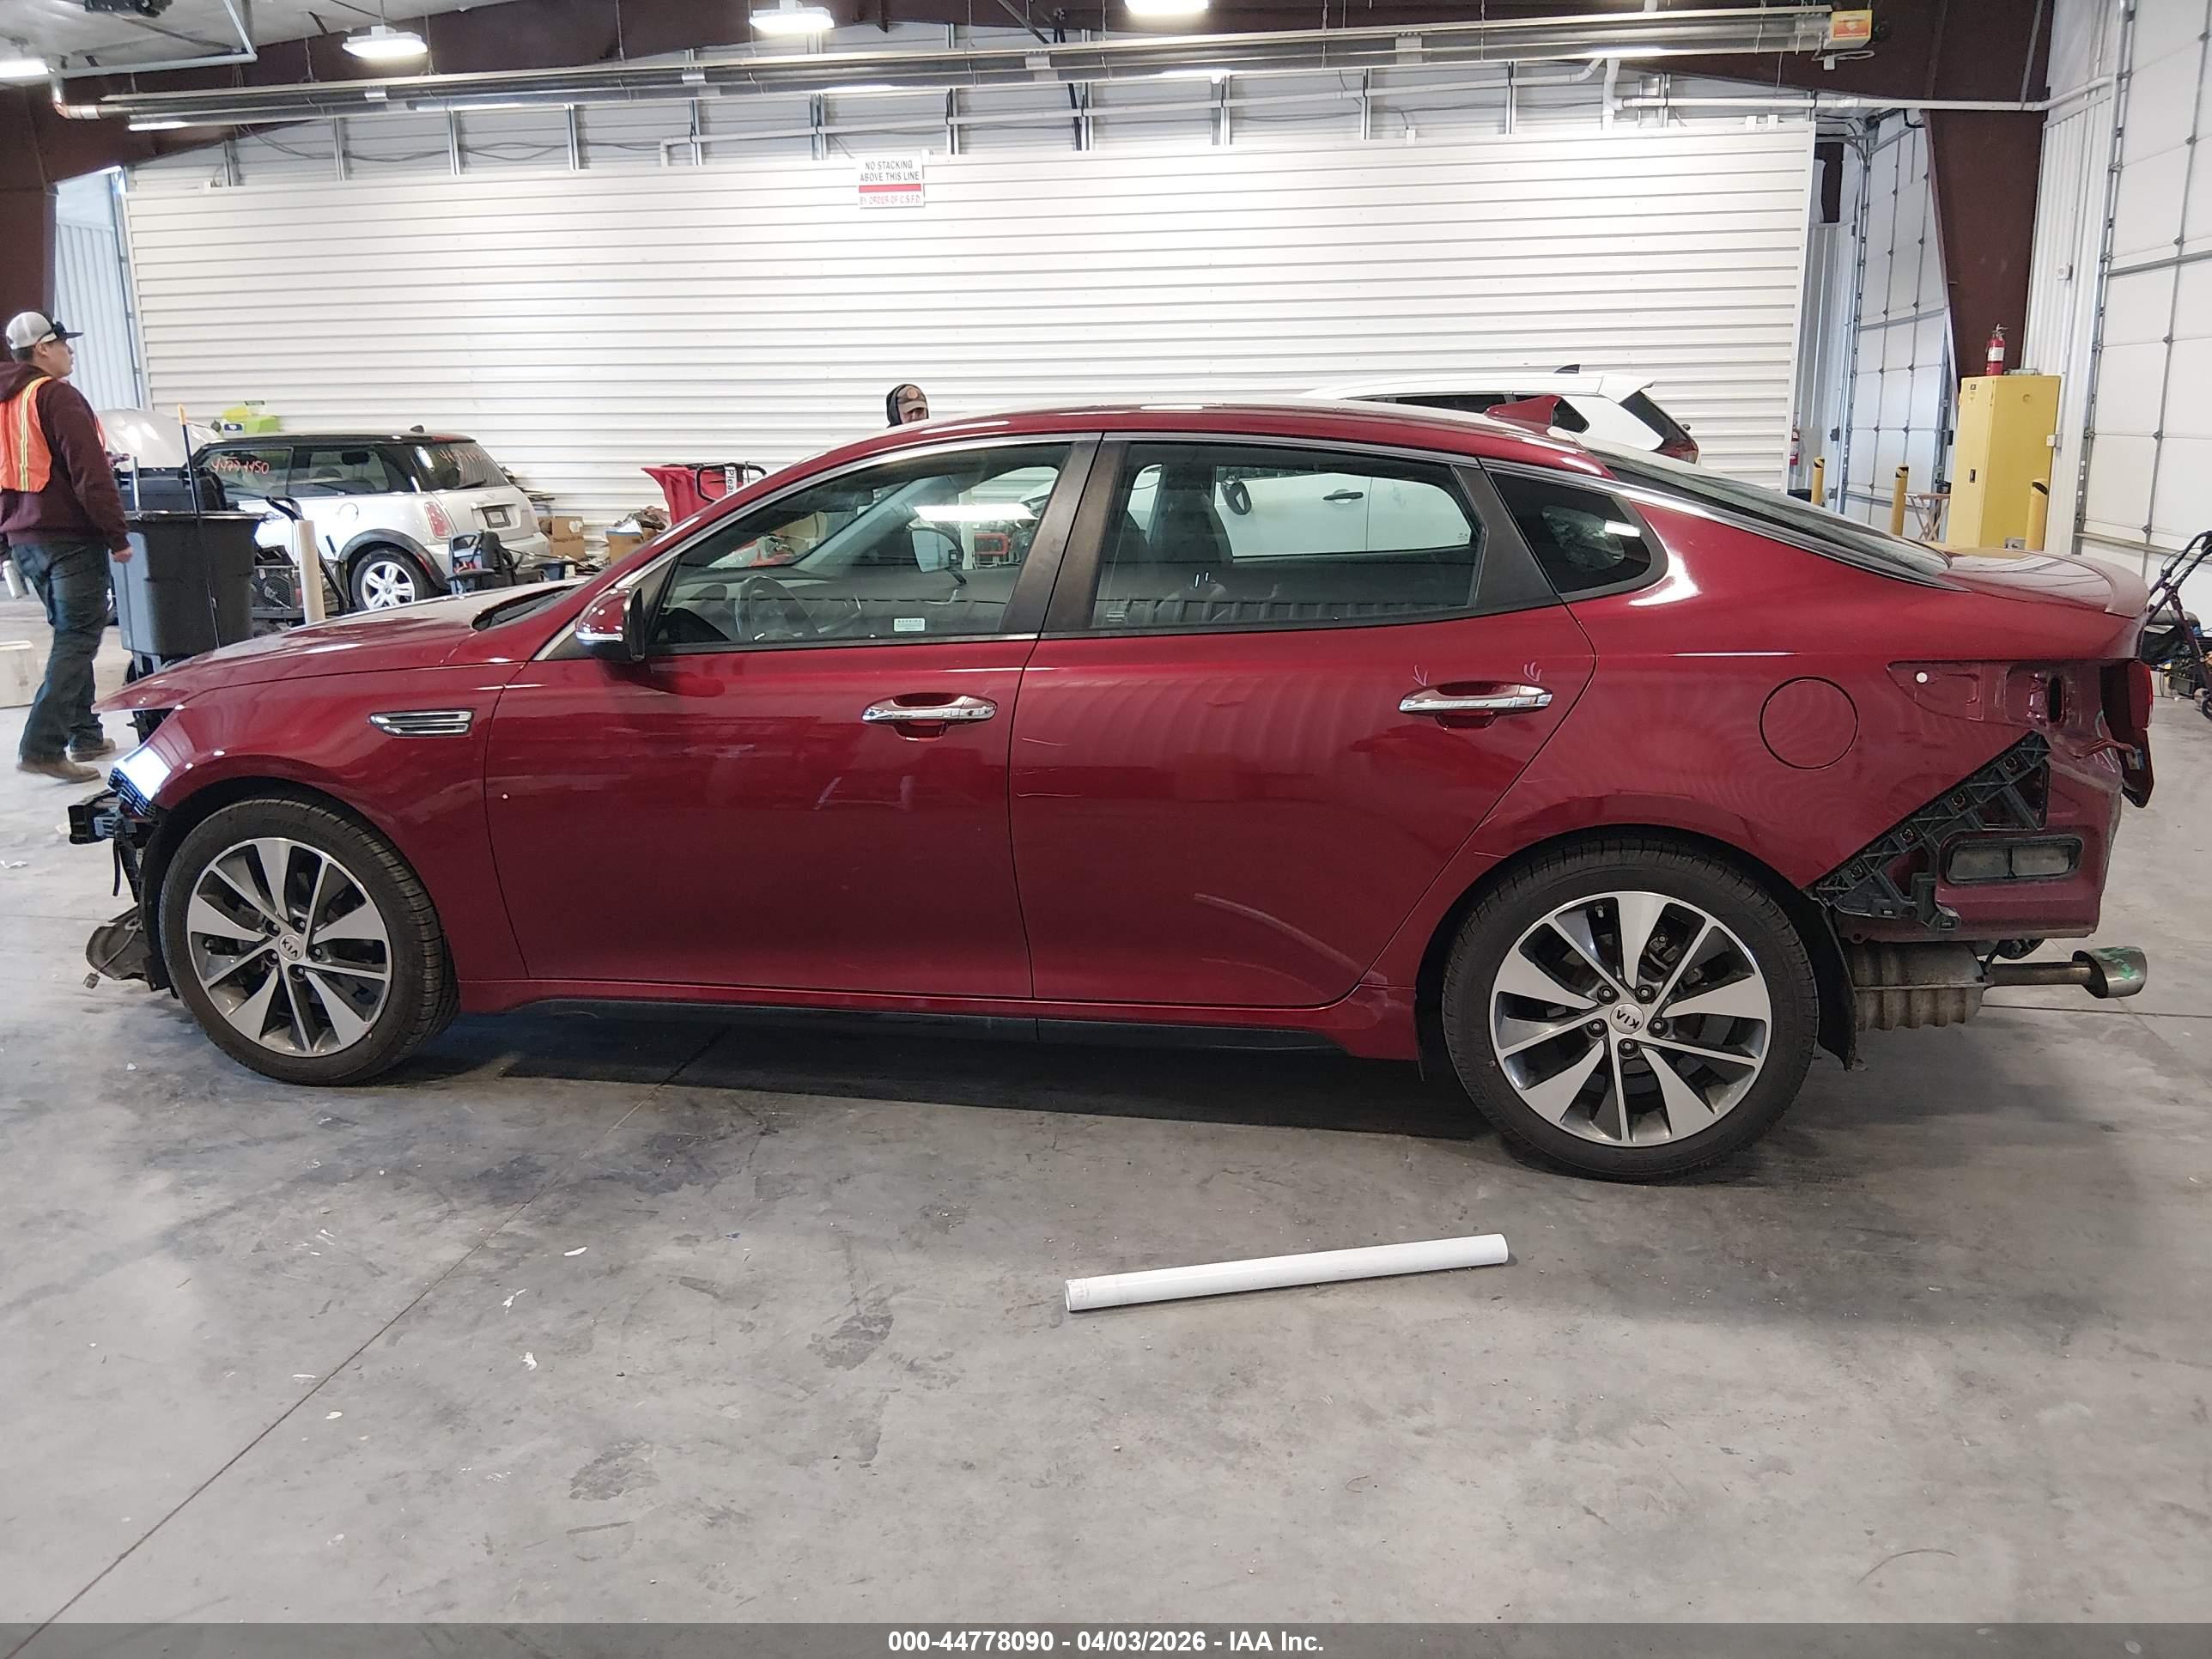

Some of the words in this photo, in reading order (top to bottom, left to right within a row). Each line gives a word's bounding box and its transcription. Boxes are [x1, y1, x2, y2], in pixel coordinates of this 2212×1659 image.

[865, 161, 876, 171] NO
[878, 159, 913, 171] STACKING
[860, 173, 884, 182] ABOVE
[886, 172, 902, 182] THIS
[904, 171, 920, 180] LINE
[282, 939, 298, 957] KIA
[1616, 1009, 1640, 1029] KIA
